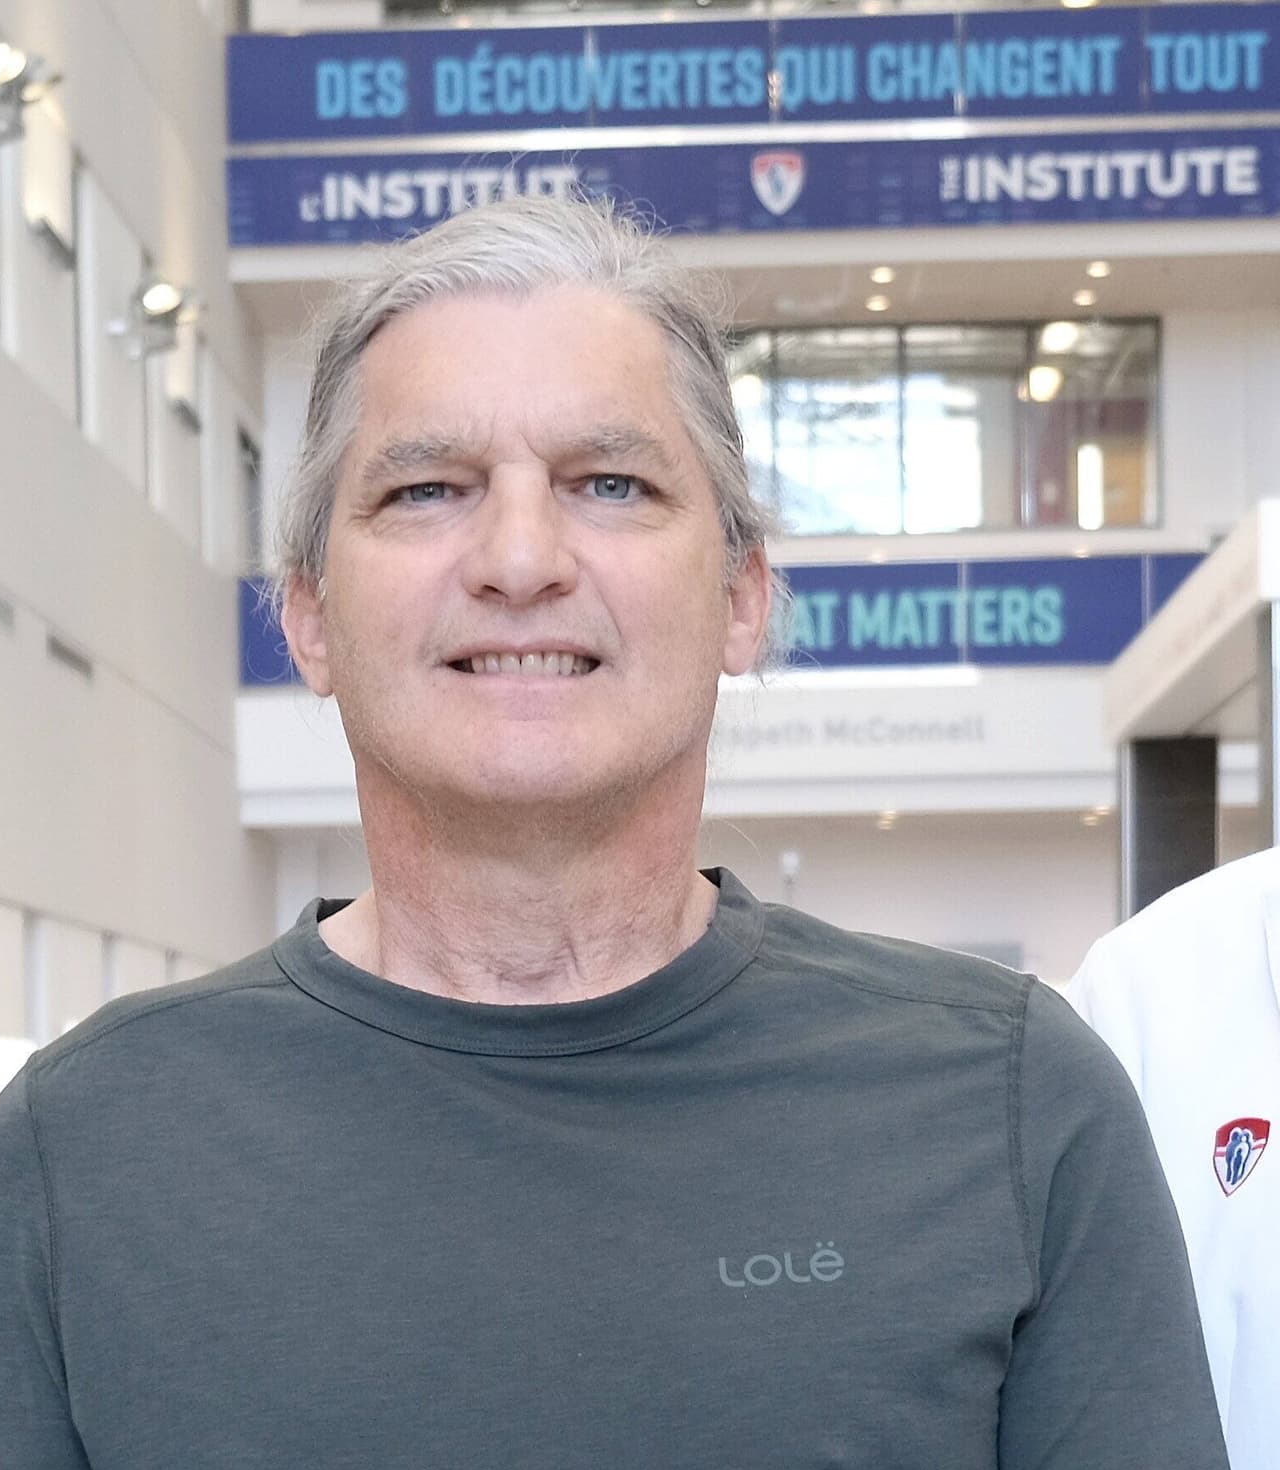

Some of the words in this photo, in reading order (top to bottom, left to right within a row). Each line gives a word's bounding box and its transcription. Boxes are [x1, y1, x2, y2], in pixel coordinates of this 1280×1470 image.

[316, 60, 407, 119] DES
[435, 41, 764, 116] DÉCOUVERTES
[778, 46, 854, 111] QUI
[867, 36, 1122, 99] CHANGENT
[1146, 31, 1269, 91] TOUT
[965, 147, 1261, 201] INSTITUTE
[849, 587, 1064, 649] MATTERS
